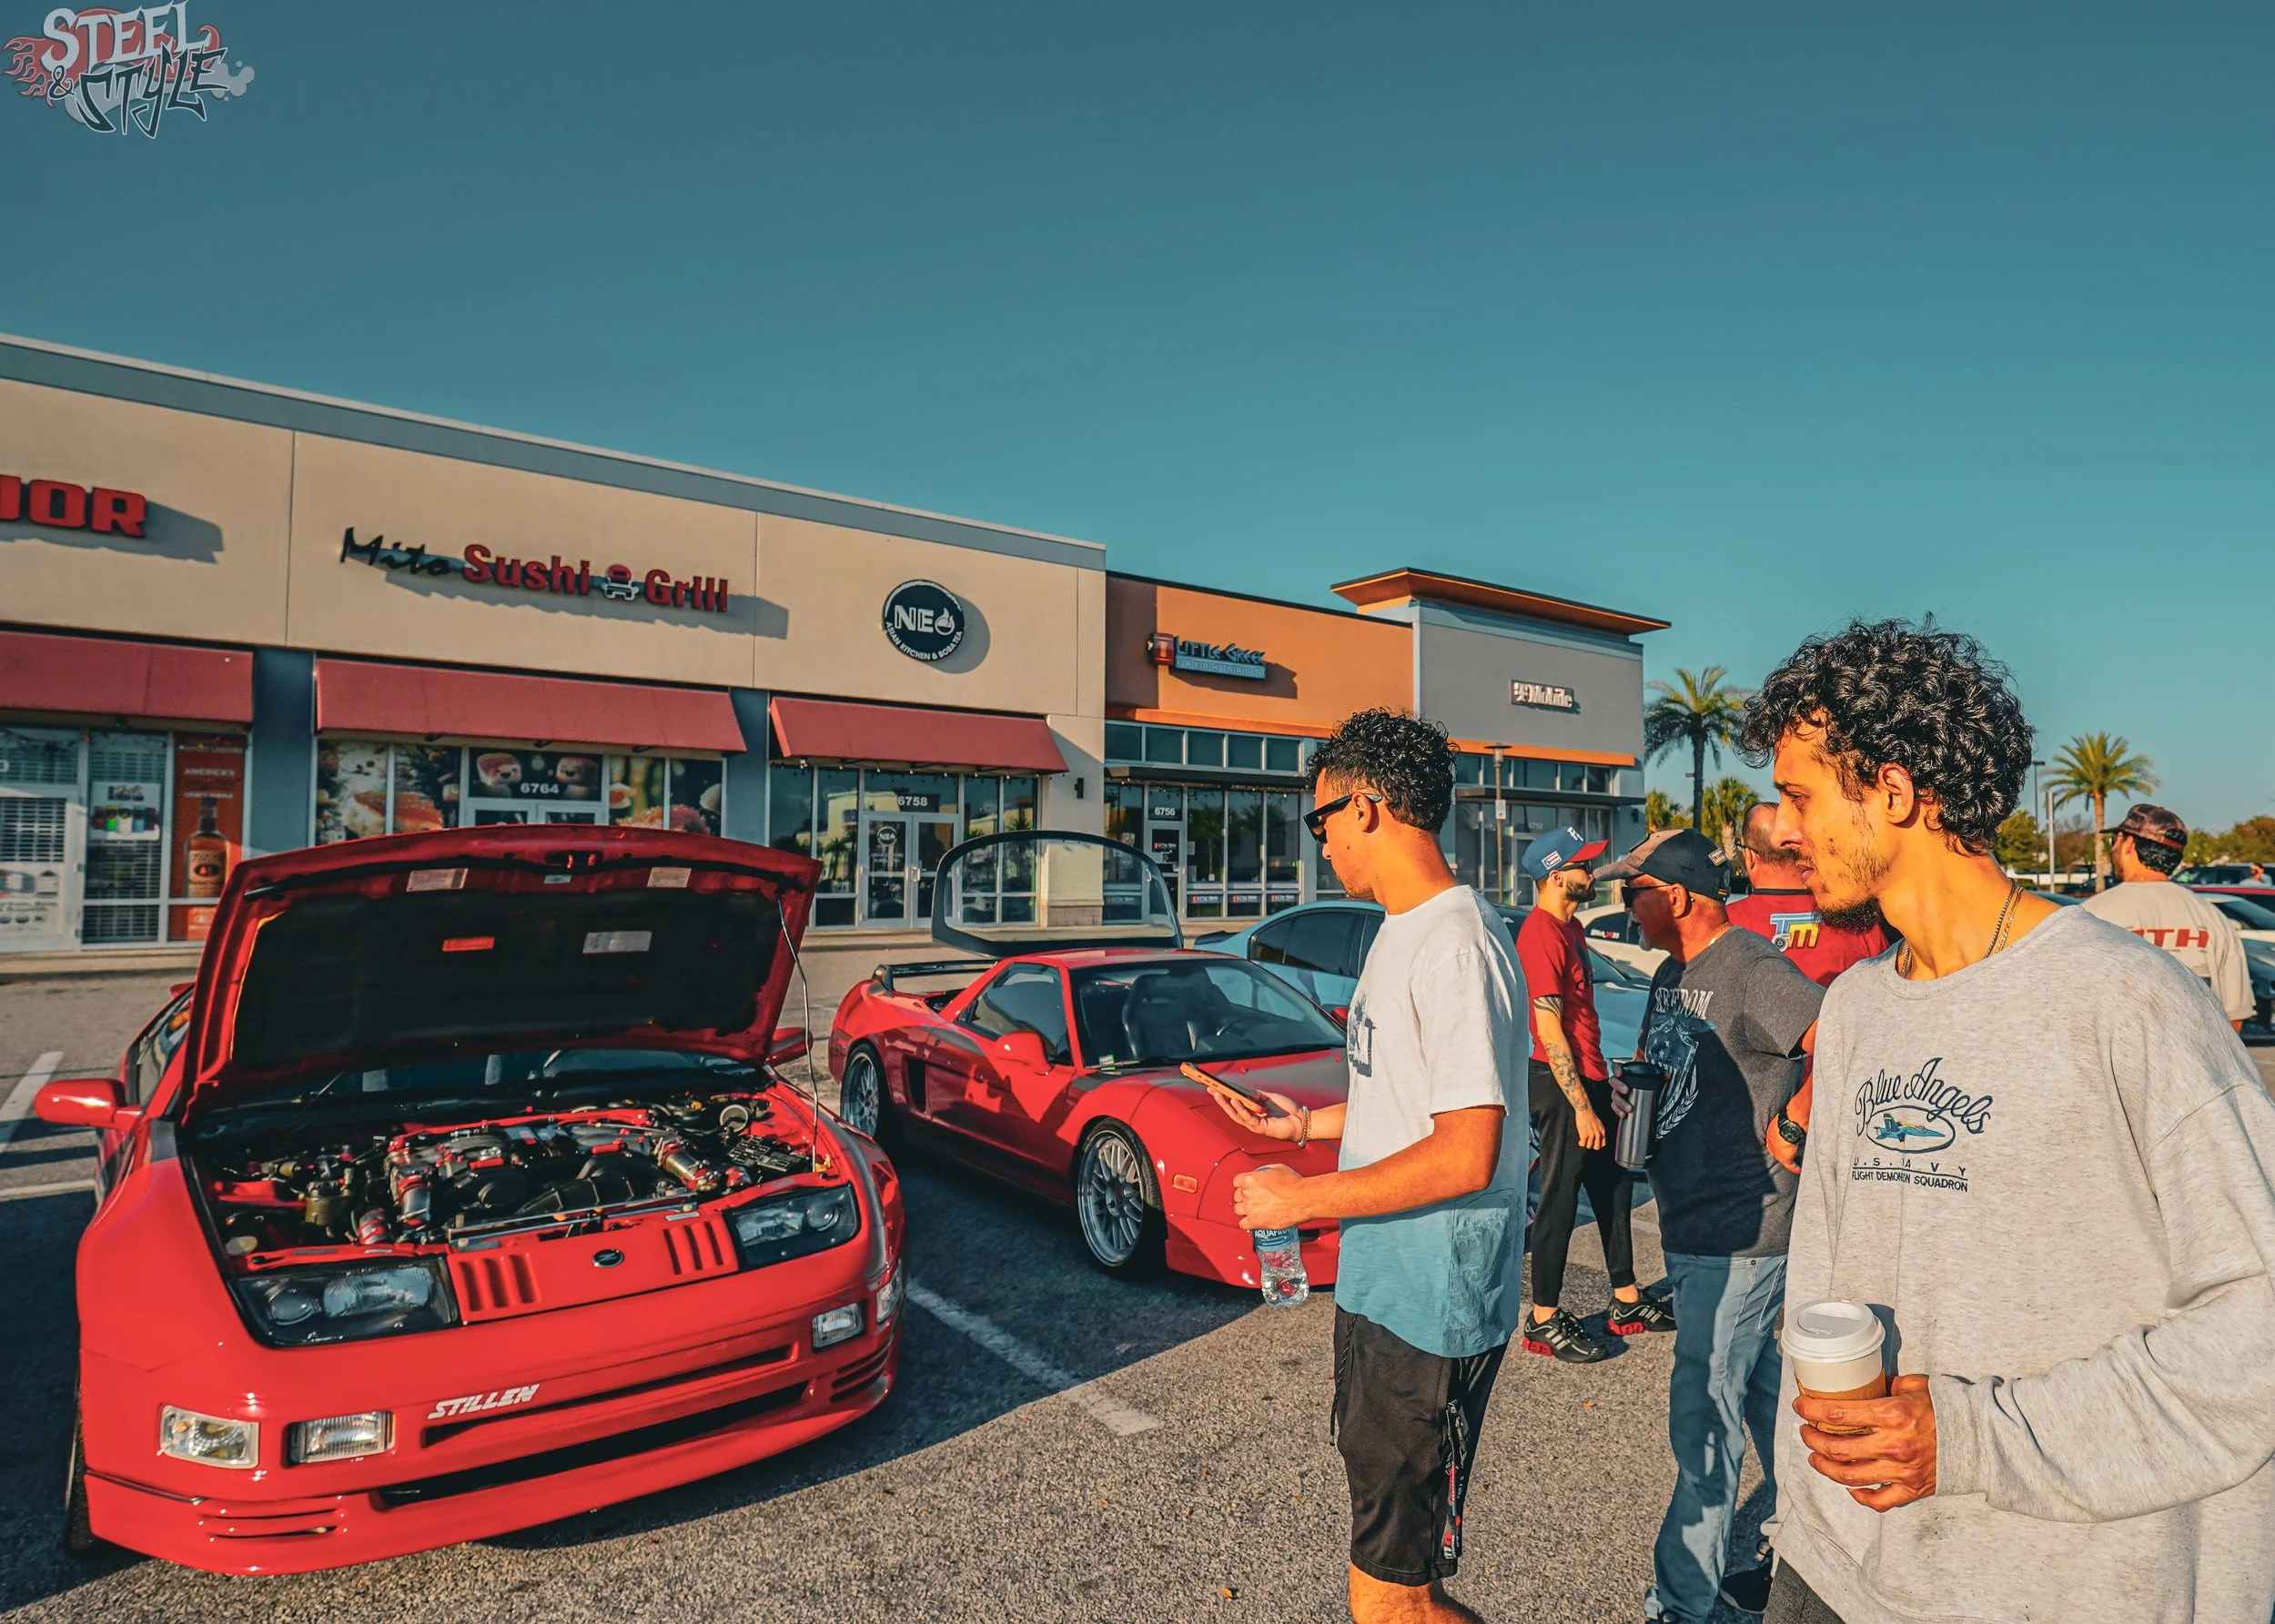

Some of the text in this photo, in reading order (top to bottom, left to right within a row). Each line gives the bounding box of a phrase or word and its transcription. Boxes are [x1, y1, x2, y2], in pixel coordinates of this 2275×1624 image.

[339, 526, 729, 612] Mito Sushi Grill
[885, 621, 964, 661] ASIAN KITCHEN & BOBA TEA
[520, 782, 561, 795] 6764
[896, 795, 929, 808] 6758
[1154, 806, 1176, 817] 6756
[2131, 928, 2209, 949] TH
[1855, 1056, 1994, 1137] Blue Angels
[1852, 1171, 1875, 1181] FLIGHT
[1913, 1175, 1969, 1193] SQUADRON
[1254, 1228, 1289, 1239] AQUAFIN
[427, 1383, 541, 1420] STILLEN
